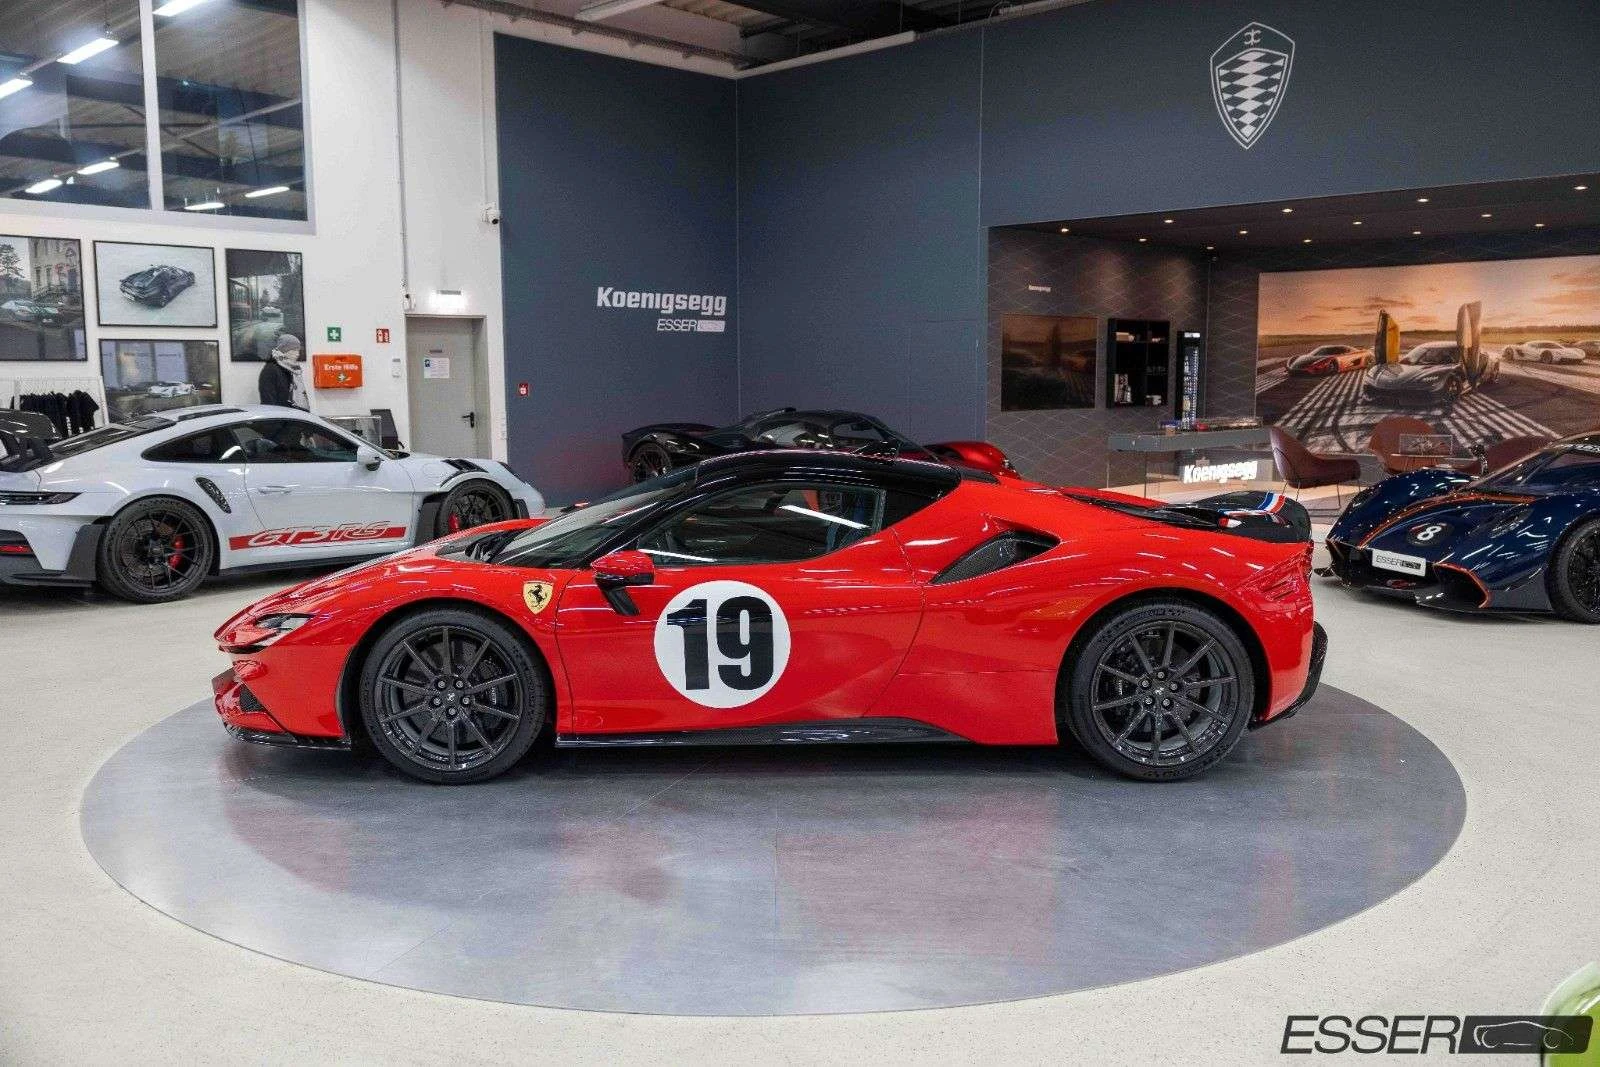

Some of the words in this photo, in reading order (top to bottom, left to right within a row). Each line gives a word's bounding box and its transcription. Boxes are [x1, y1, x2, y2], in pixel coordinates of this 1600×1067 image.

[596, 286, 727, 316] Koenigsegg
[656, 318, 698, 332] ESSER
[1416, 525, 1442, 541] 8
[666, 595, 774, 691] 19
